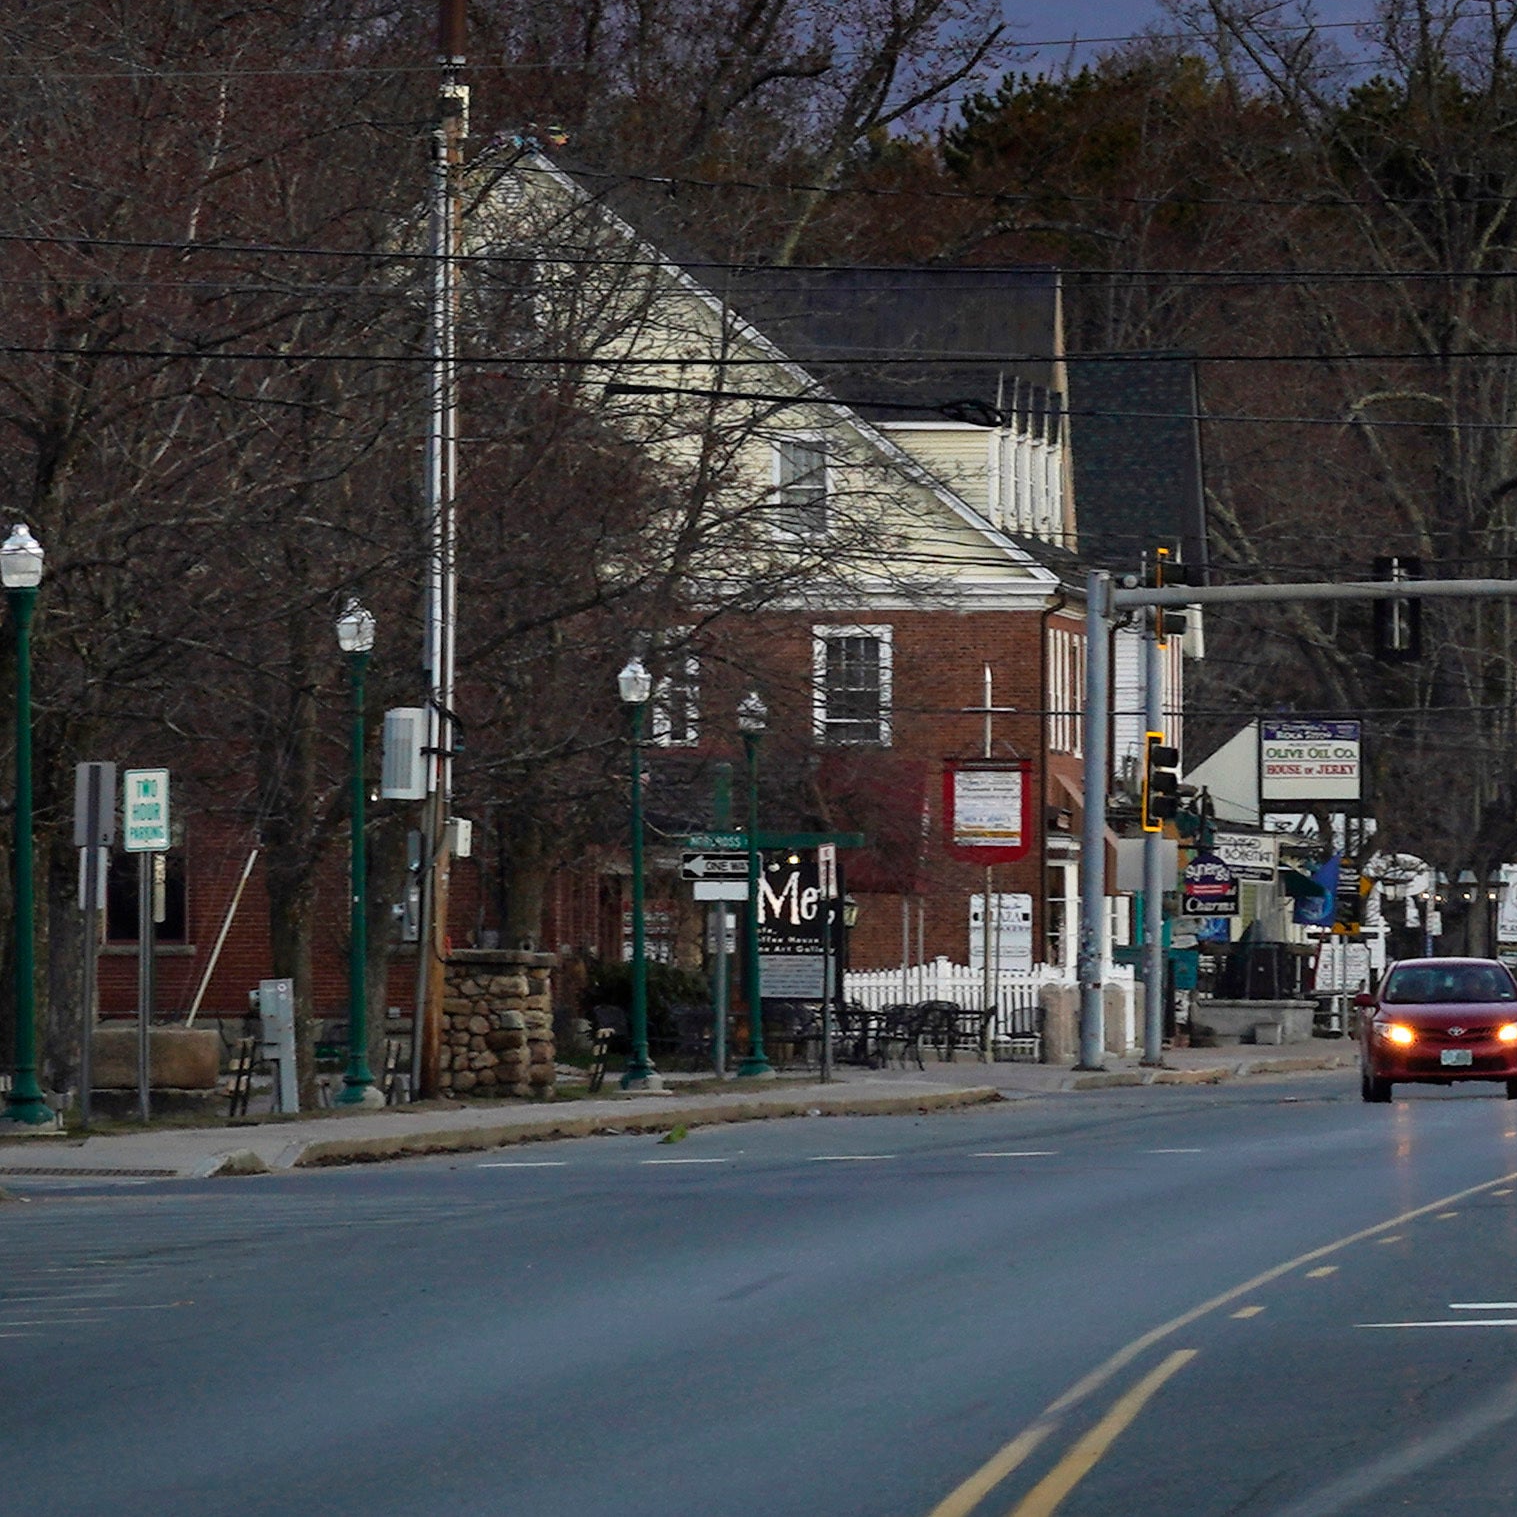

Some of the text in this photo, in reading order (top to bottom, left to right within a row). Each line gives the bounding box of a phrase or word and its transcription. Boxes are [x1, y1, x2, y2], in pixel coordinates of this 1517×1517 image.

[1266, 747, 1304, 758] OLIVE
[1307, 747, 1331, 758] OIL
[1266, 764, 1302, 775] HOUSE
[1316, 764, 1356, 775] JERKY
[136, 779, 158, 798] TWO
[132, 803, 161, 821] HOUR
[130, 826, 164, 840] PARKING
[705, 862, 749, 872] ONE WA
